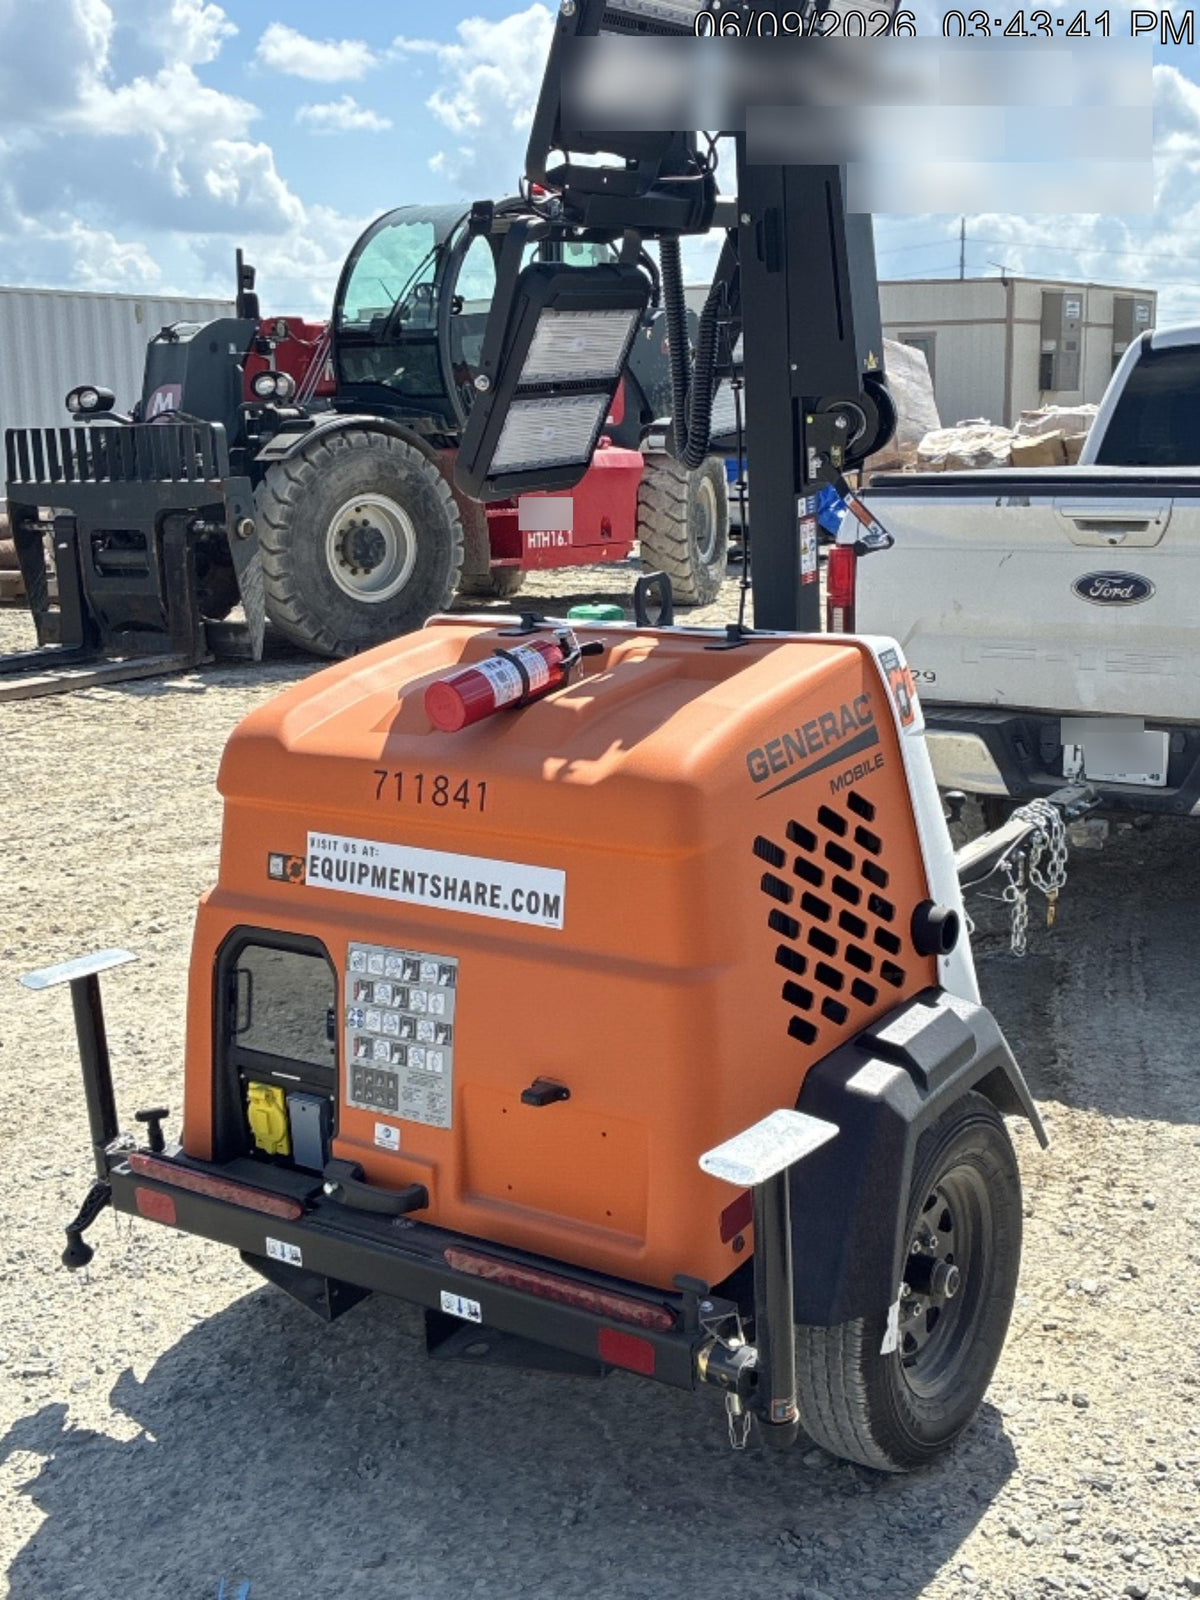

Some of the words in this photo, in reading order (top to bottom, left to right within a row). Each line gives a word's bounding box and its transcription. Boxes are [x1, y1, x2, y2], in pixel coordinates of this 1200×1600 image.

[1089, 577, 1135, 599] Ford
[746, 693, 874, 784] GENERAC
[373, 769, 487, 812] 711841
[829, 752, 885, 795] MOBILE
[310, 837, 339, 852] VISIT
[343, 842, 357, 854] US
[362, 845, 380, 858] AT:
[309, 854, 561, 920] EQUIPMENTSHARE.COM
